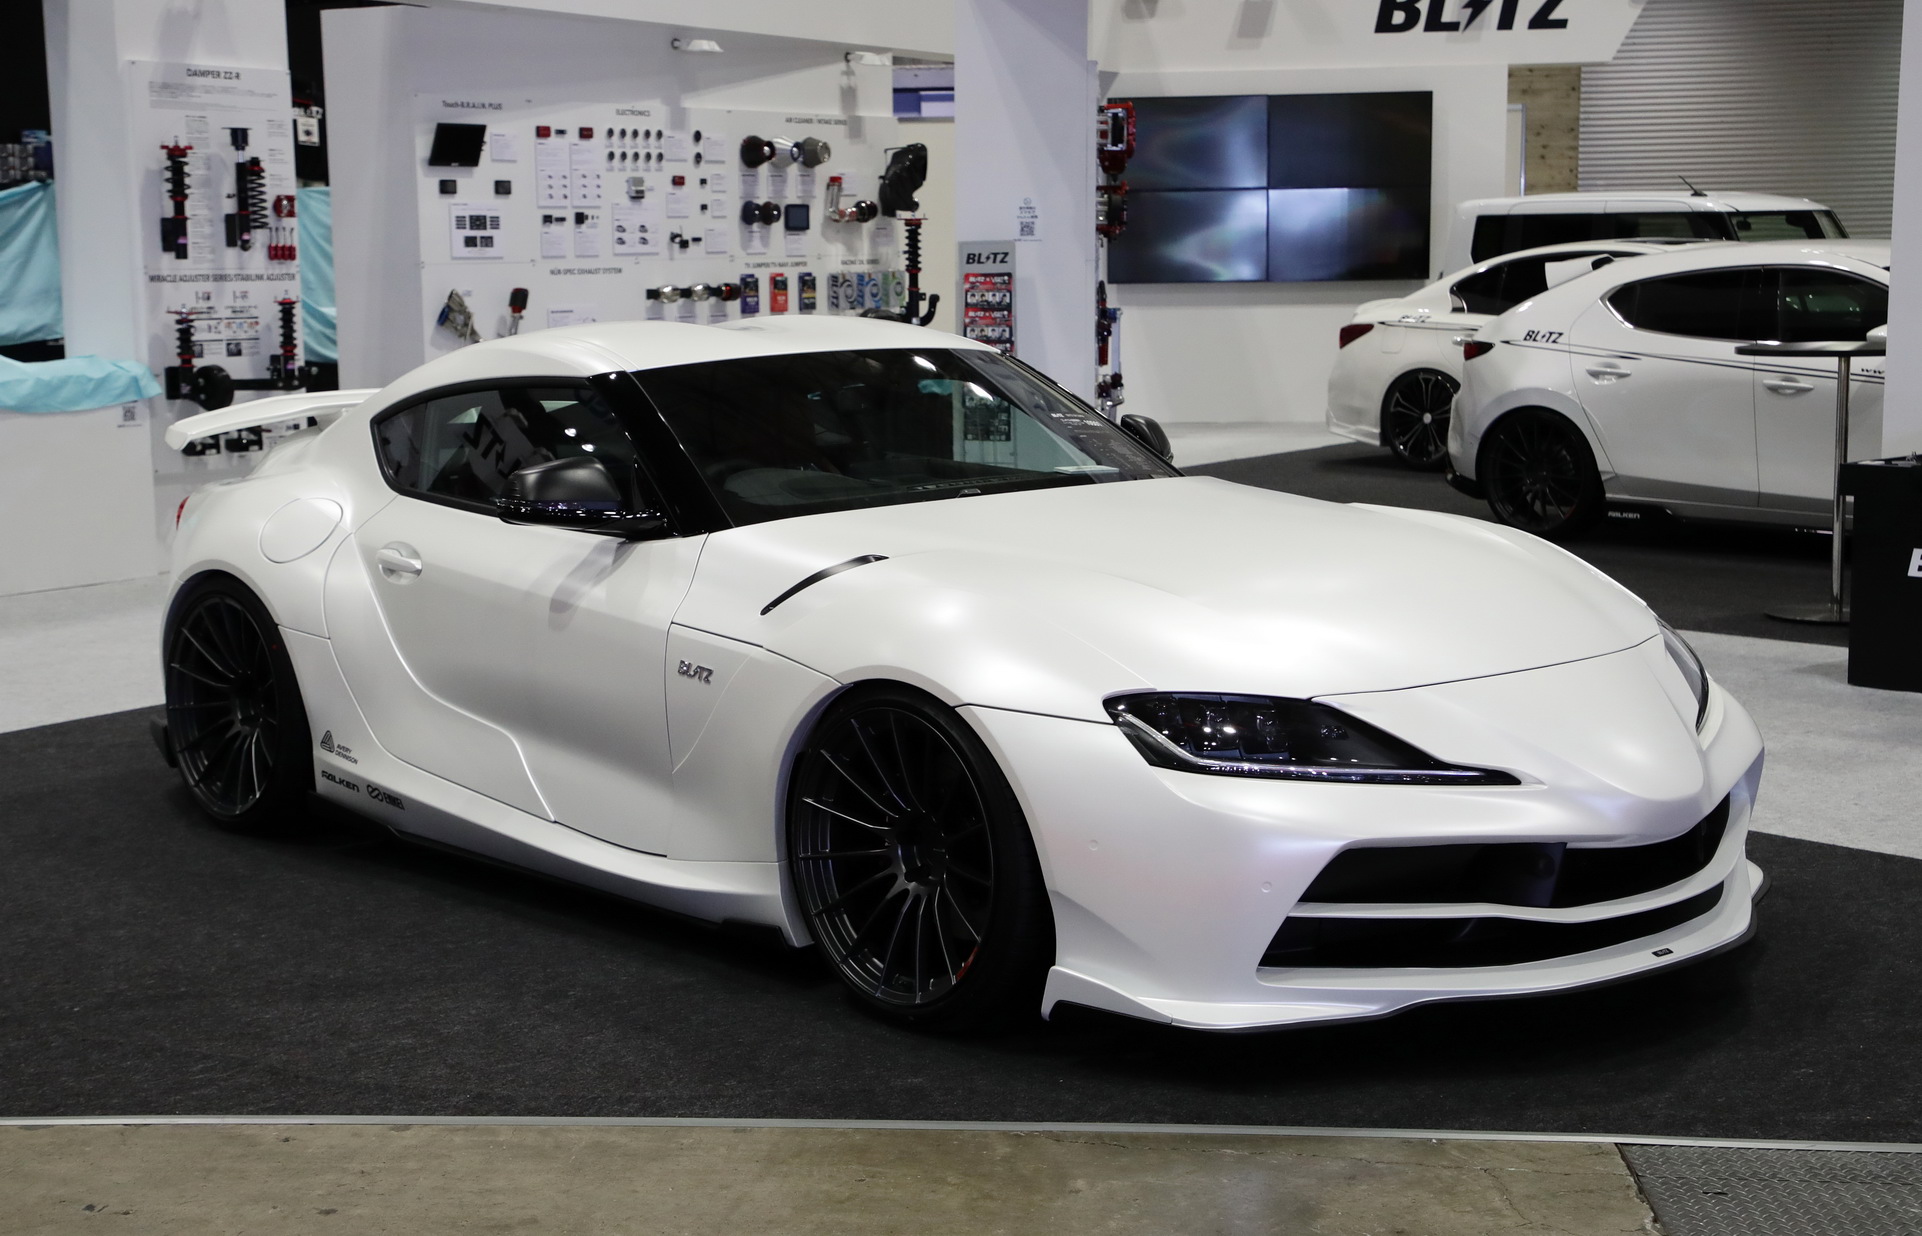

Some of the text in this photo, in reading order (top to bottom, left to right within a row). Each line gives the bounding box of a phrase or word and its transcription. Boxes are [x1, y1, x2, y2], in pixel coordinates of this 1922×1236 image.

[186, 68, 221, 79] DAMPER
[615, 109, 651, 117] ELECTRONICS
[965, 252, 1009, 265] BLITZ
[1523, 330, 1564, 344] BLITZ
[678, 659, 714, 686] BLITZ
[336, 743, 353, 755] AVERY
[321, 770, 360, 793] FALKEN
